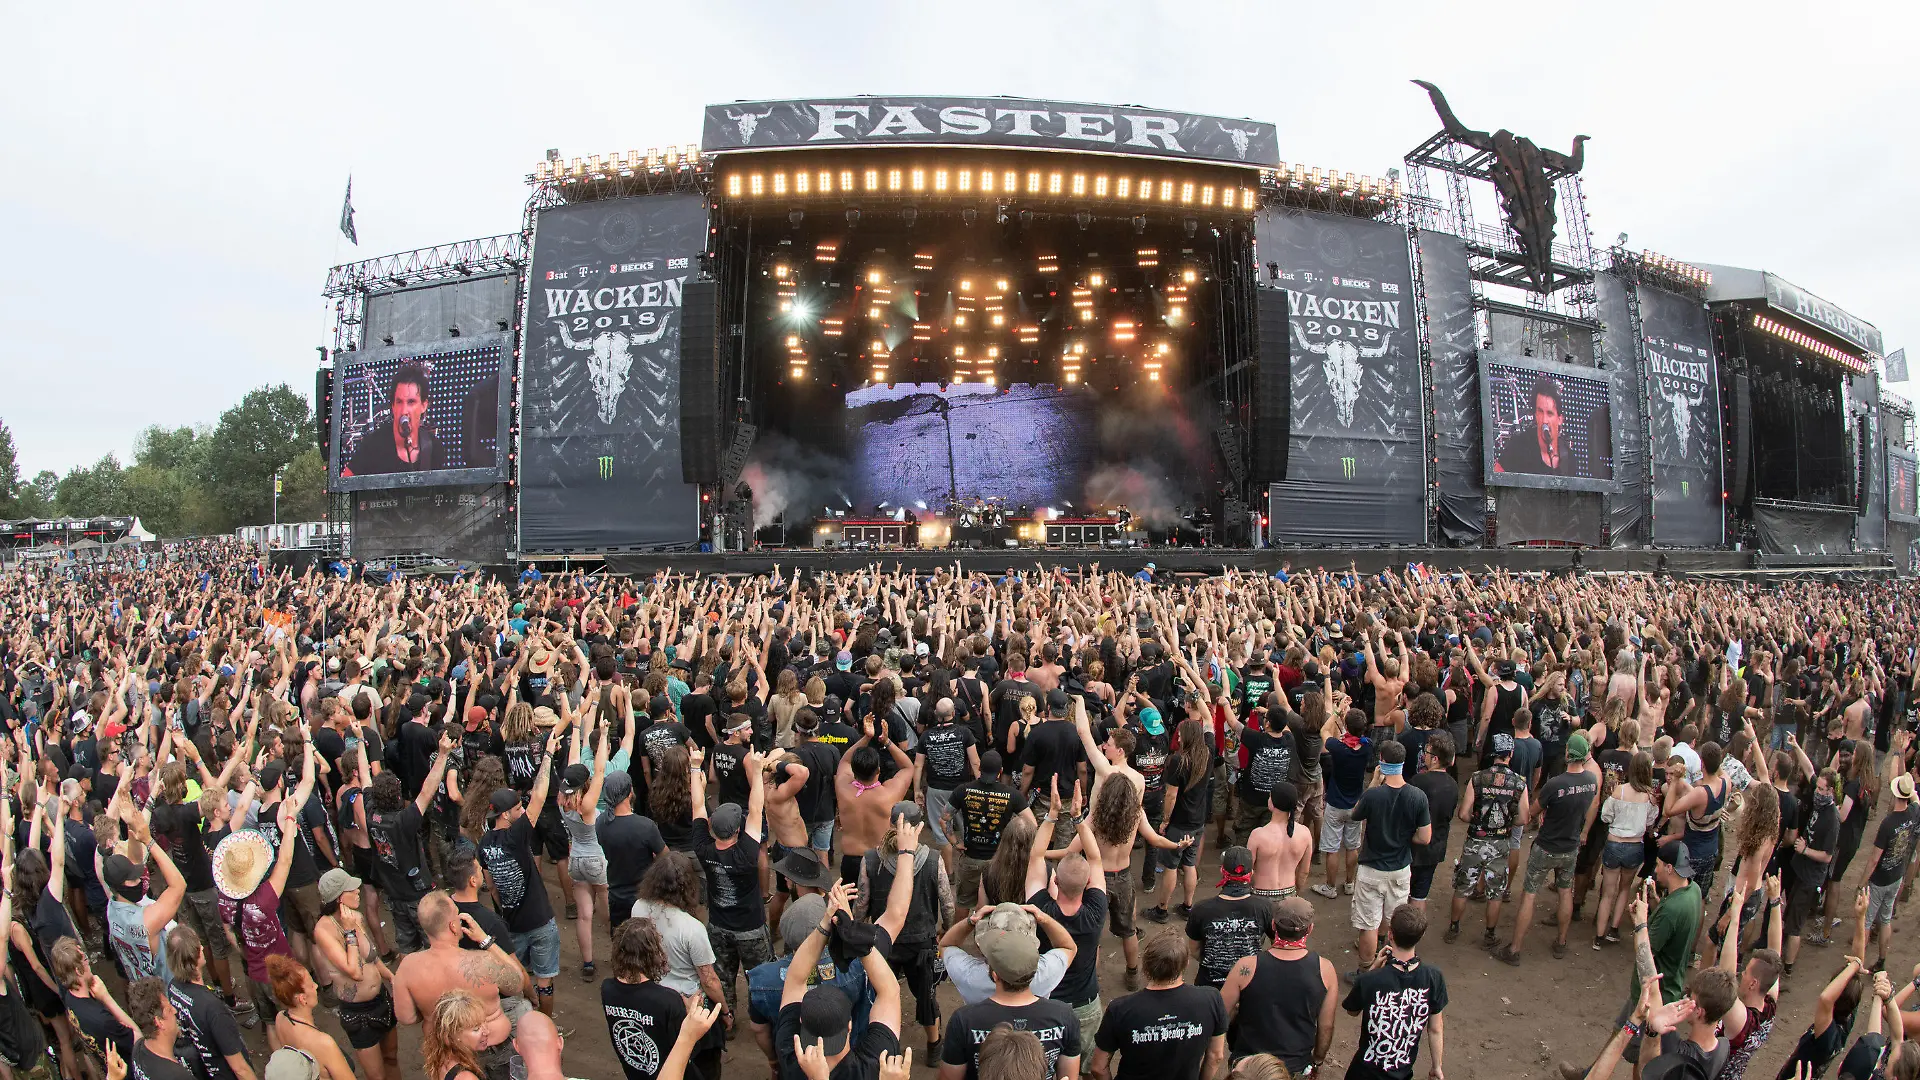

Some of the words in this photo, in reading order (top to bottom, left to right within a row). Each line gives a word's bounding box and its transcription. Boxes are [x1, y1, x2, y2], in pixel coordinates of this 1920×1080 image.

[807, 103, 1187, 152] FASTER
[545, 275, 688, 318] WACKEN
[572, 312, 656, 332] 2018
[1795, 288, 1869, 347] HARDER
[1306, 321, 1379, 340] 2018
[1648, 348, 1709, 384] WACKEN
[1663, 376, 1699, 393] 2018
[1375, 990, 1400, 1006] WE
[1400, 988, 1430, 1005] ARE
[605, 1005, 654, 1026] BURZUM
[1369, 1004, 1409, 1020] HERE
[1412, 1002, 1429, 1017] TO
[1187, 1023, 1203, 1038] Pub
[1367, 1016, 1429, 1040] DRINK
[1366, 1034, 1418, 1055] YOUR
